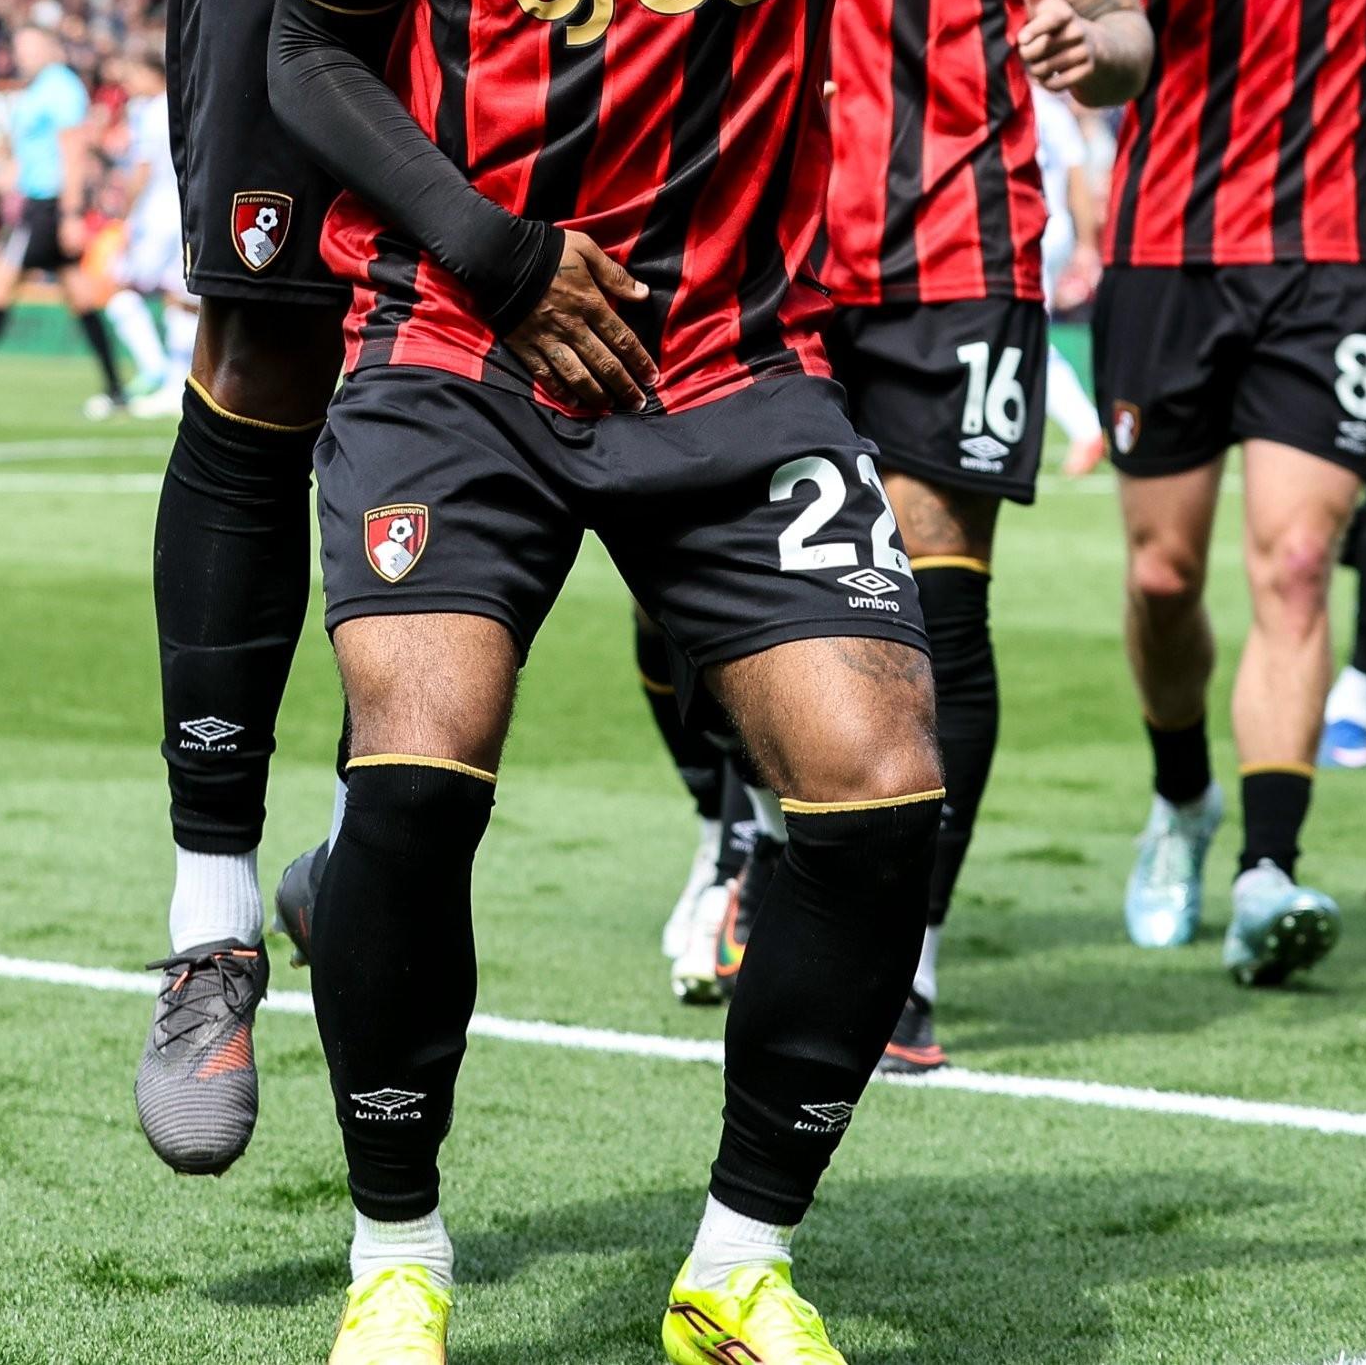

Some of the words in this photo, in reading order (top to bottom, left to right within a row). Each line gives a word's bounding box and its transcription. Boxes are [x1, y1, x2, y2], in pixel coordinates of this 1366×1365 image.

[957, 341, 1027, 445] 16
[769, 454, 915, 582] 22
[848, 596, 900, 613] umbro
[180, 739, 238, 752] umbro
[355, 1109, 422, 1121] umbro
